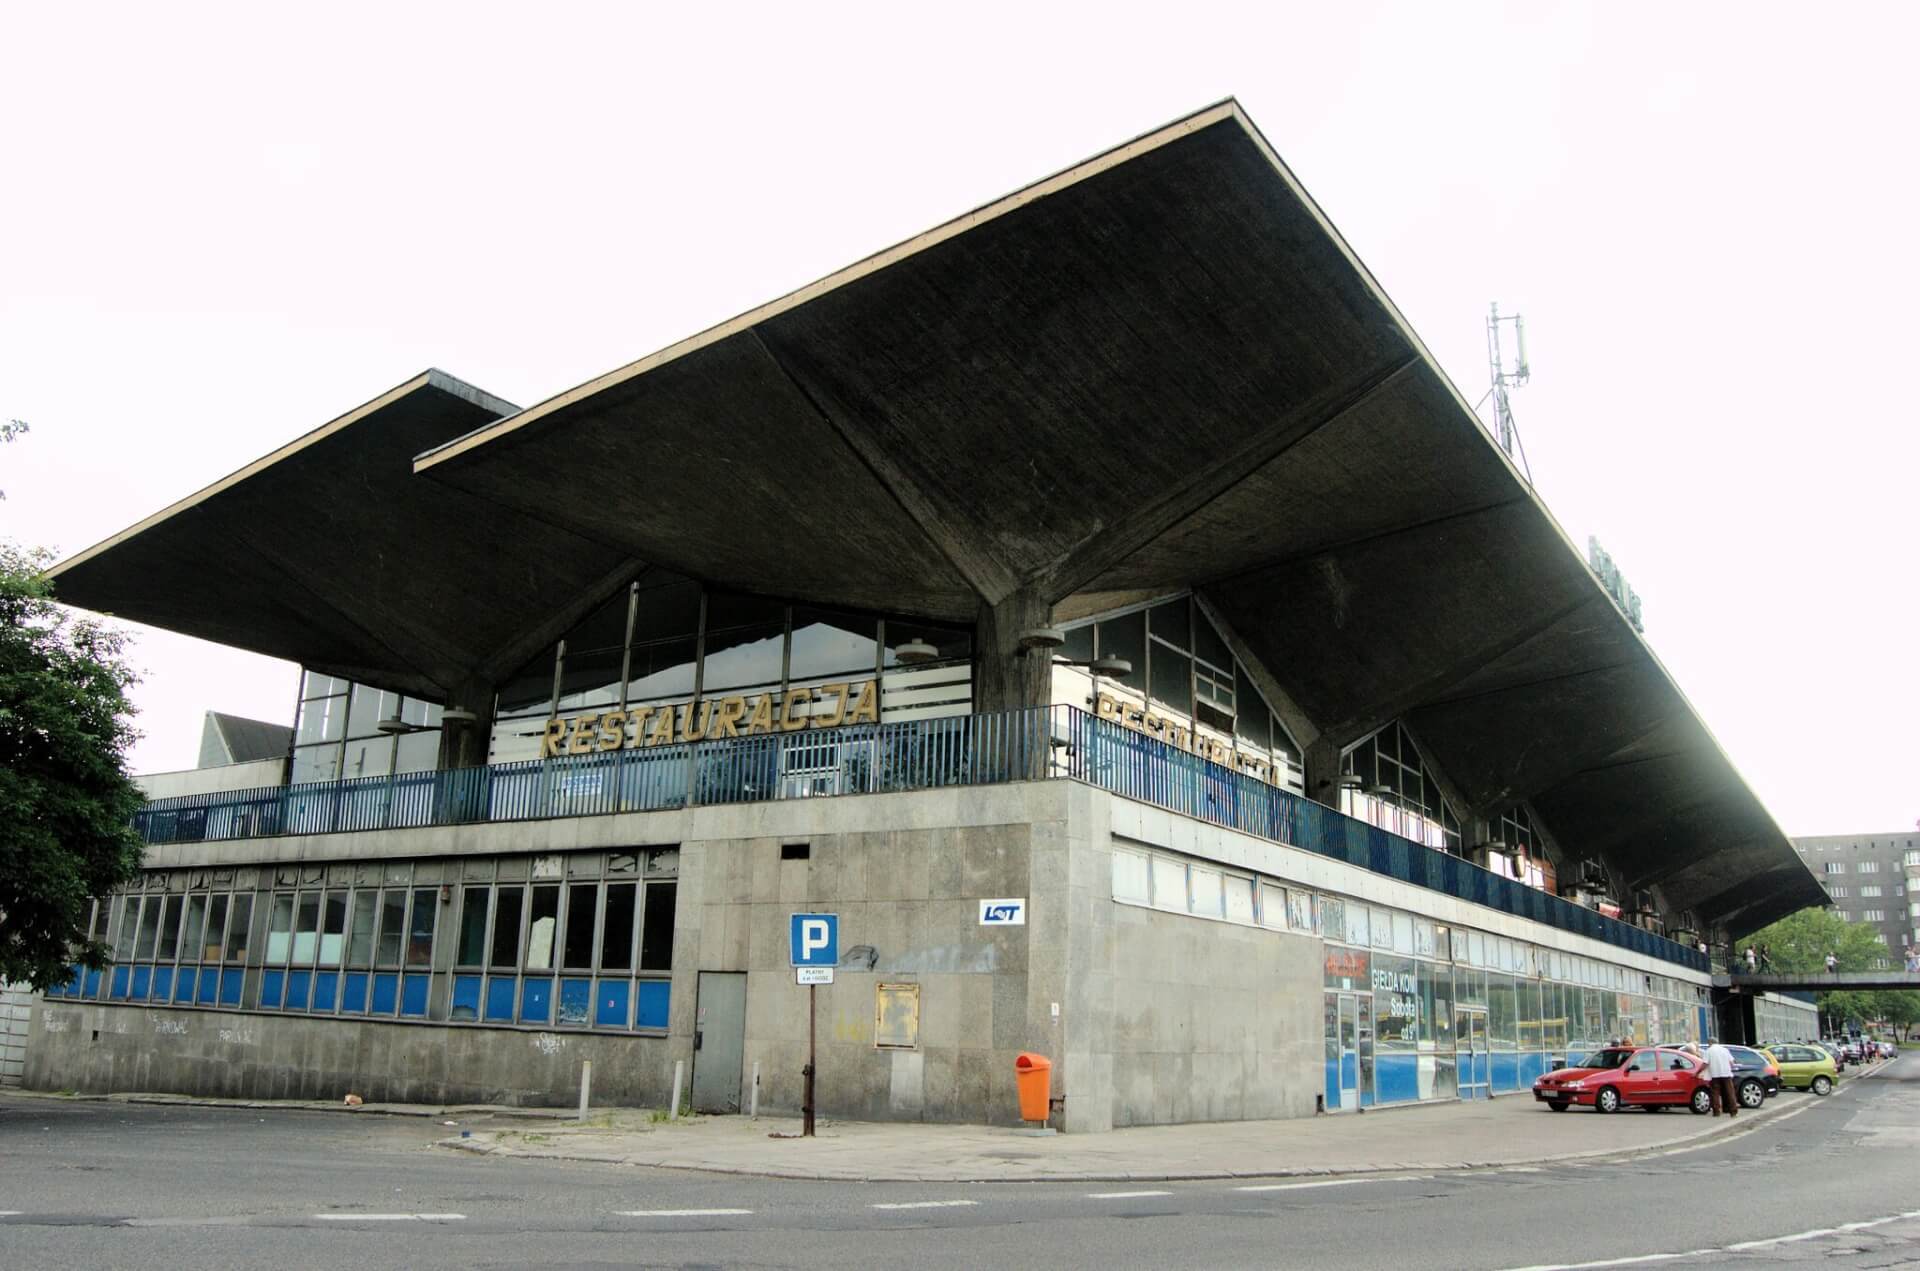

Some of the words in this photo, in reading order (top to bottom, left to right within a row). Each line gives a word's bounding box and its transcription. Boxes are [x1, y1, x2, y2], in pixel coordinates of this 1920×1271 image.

[539, 680, 878, 758] RESTAURACJA
[984, 905, 1021, 921] LOT
[802, 919, 829, 960] P
